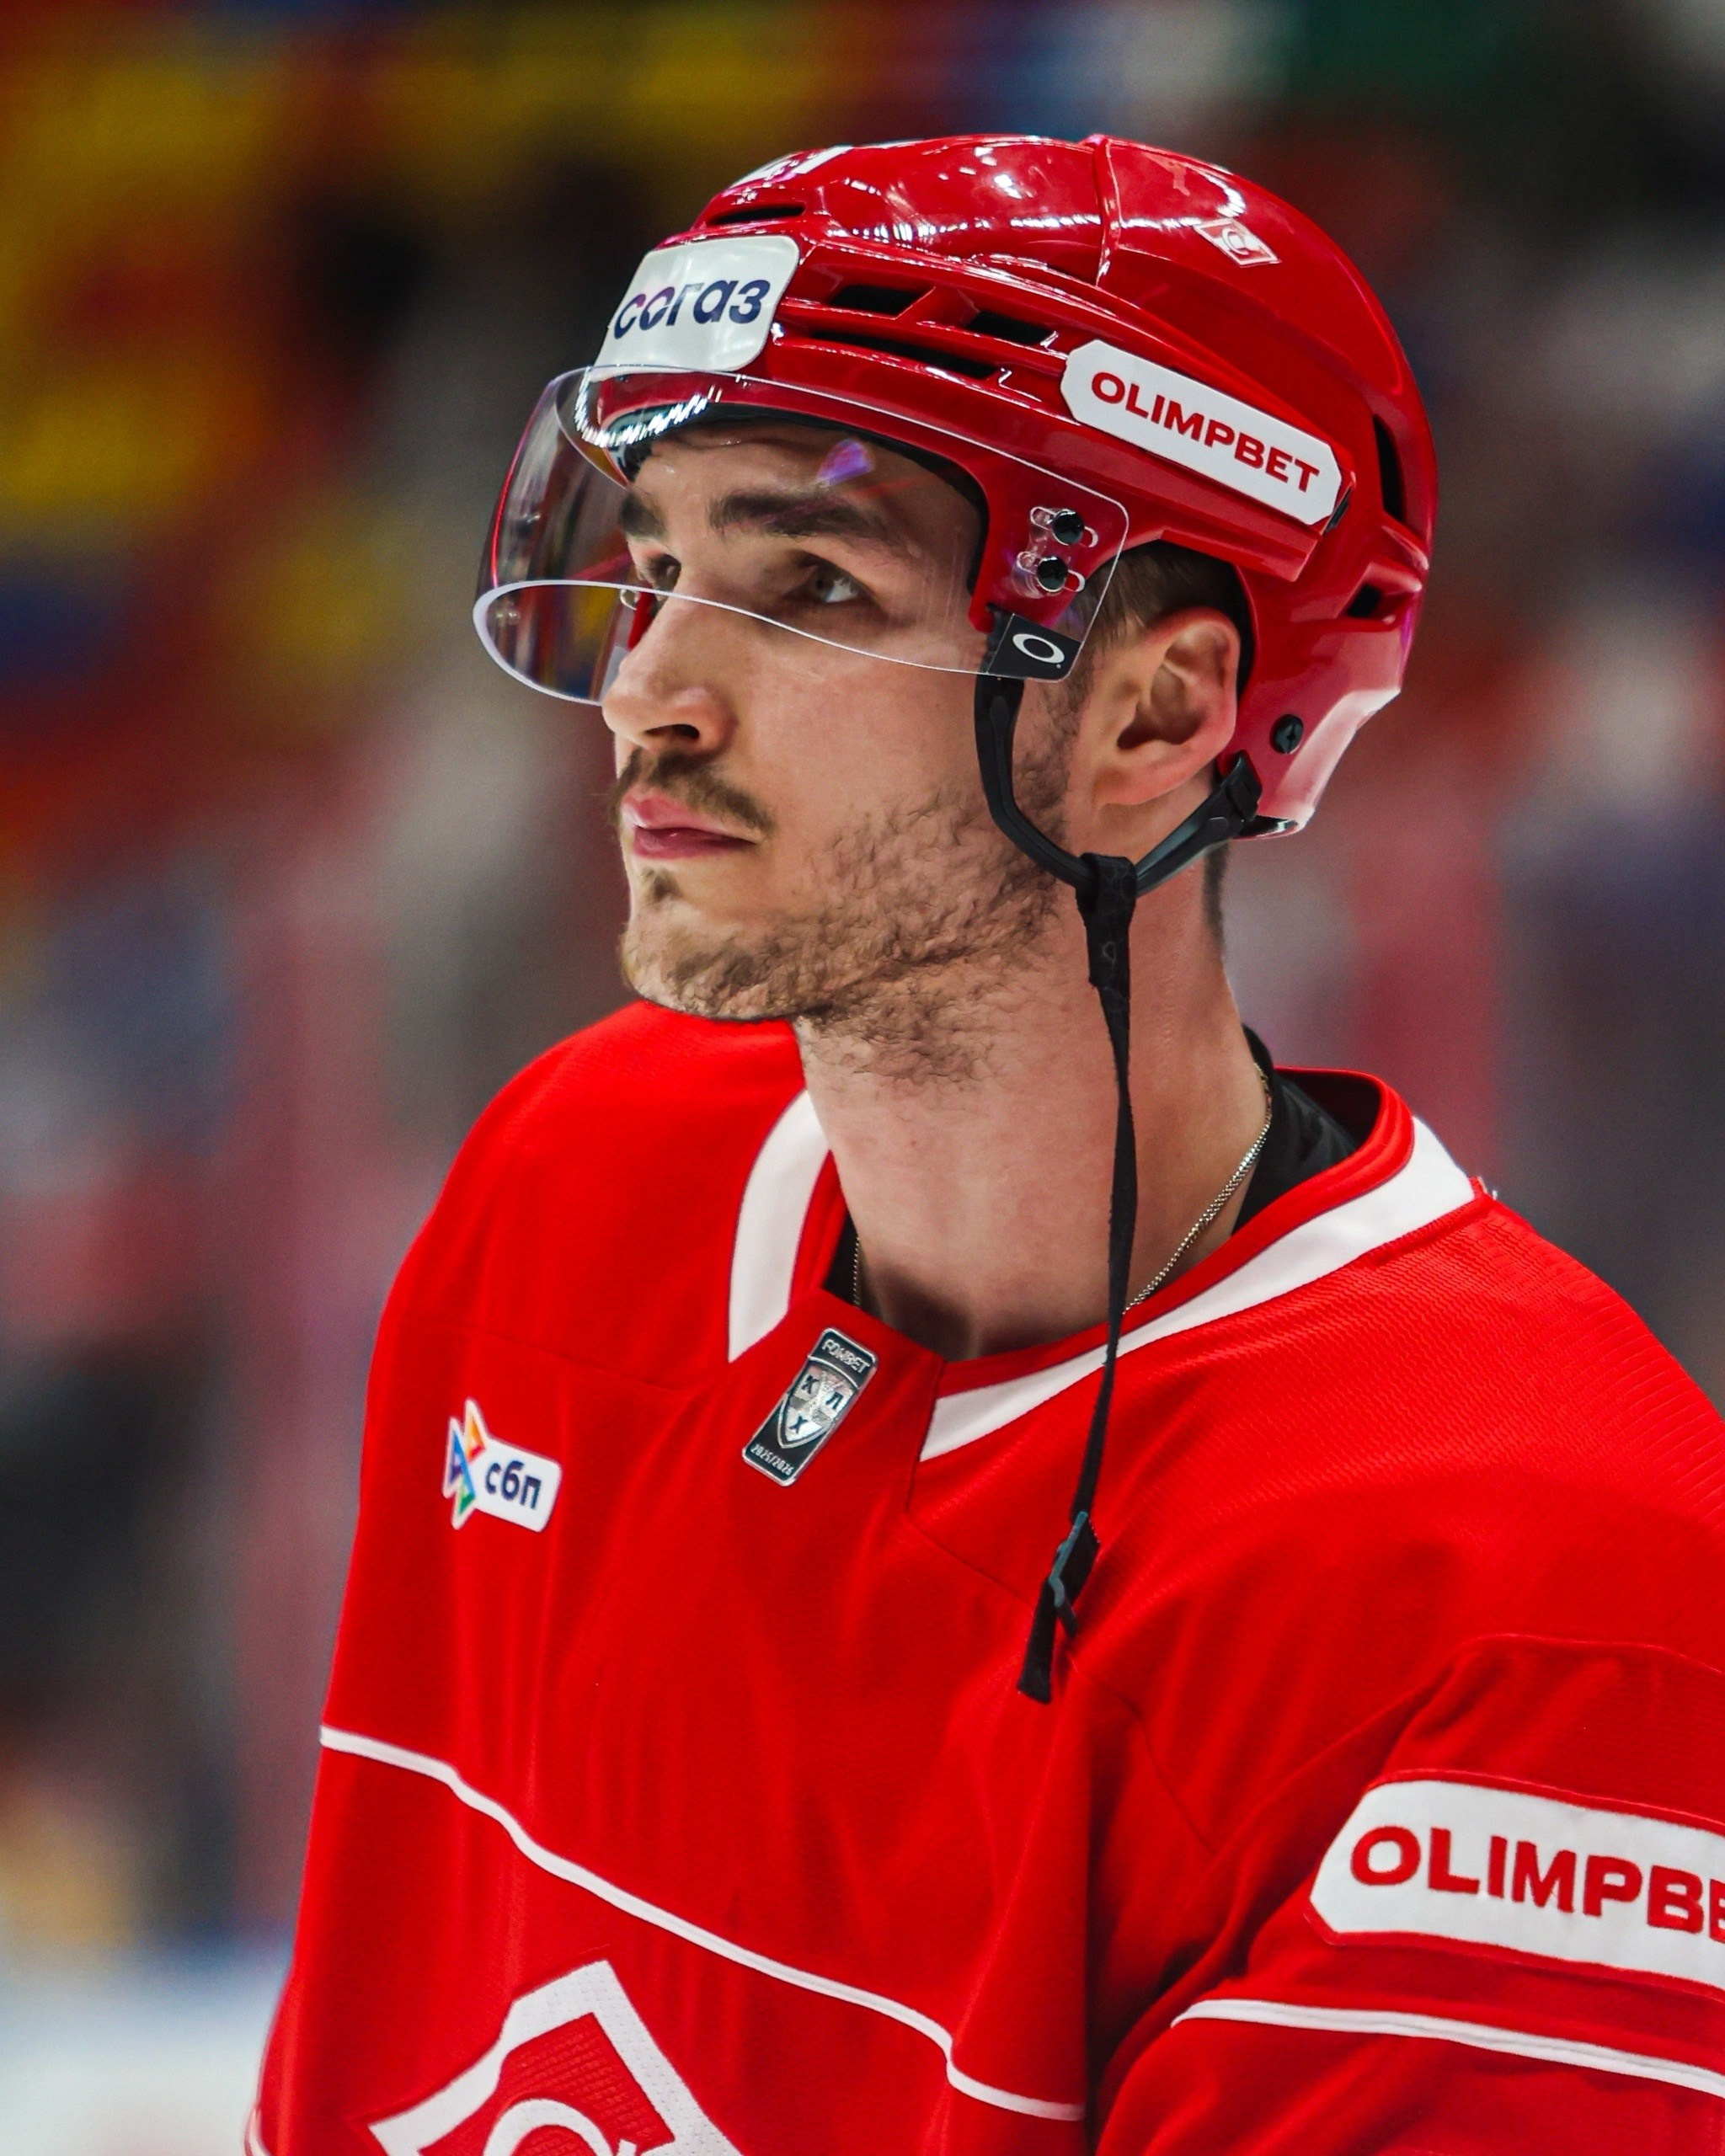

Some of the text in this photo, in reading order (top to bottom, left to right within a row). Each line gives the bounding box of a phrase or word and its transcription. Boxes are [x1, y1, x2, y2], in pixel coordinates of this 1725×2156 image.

[613, 280, 771, 339] согаз
[1091, 371, 1320, 494] OLIMPBET
[485, 1460, 542, 1509] сбп
[750, 1444, 796, 1476] 2025/2026
